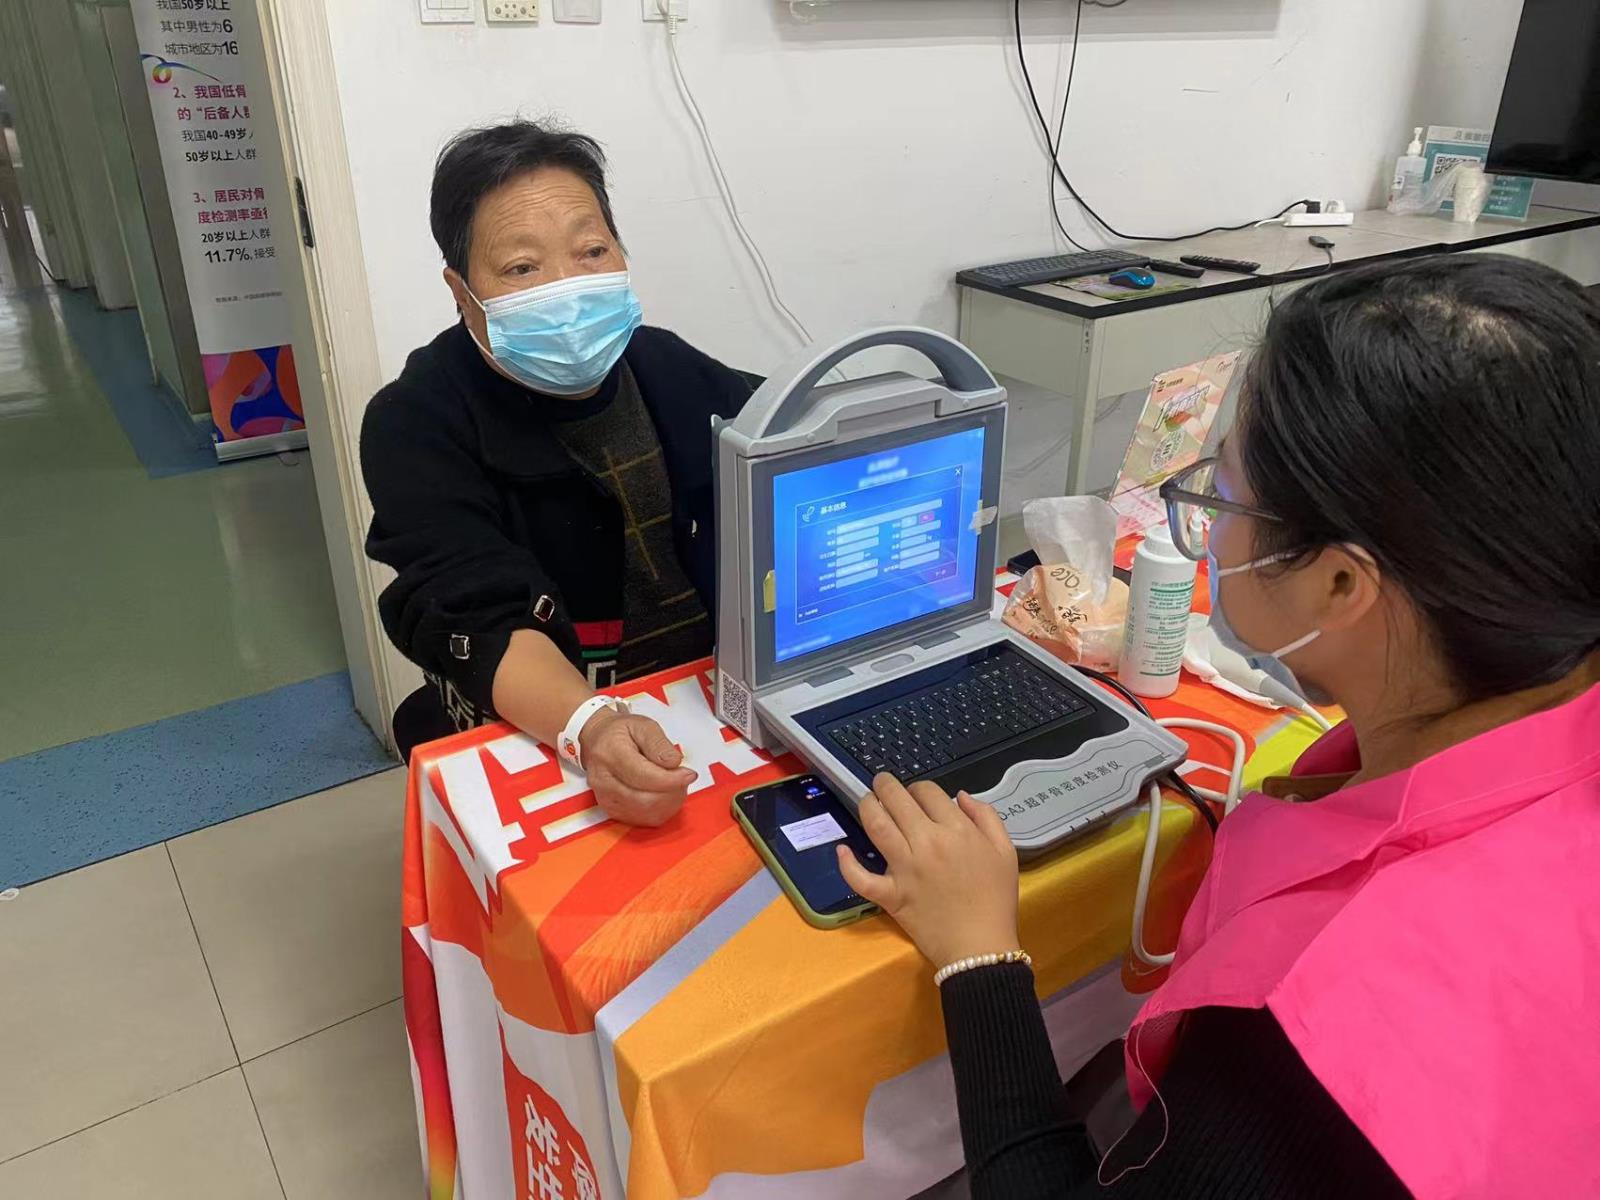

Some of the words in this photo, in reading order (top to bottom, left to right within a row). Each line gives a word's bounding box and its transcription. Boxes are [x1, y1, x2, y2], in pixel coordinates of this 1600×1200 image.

[156, 0, 231, 11] 我国50岁以上
[160, 19, 234, 34] 其中男性为6
[164, 40, 239, 56] 城市地区为16
[185, 148, 256, 162] 50岁以上人群
[201, 228, 271, 243] 20岁以上人群
[1023, 759, 1122, 810] 超声骨密度检测仪
